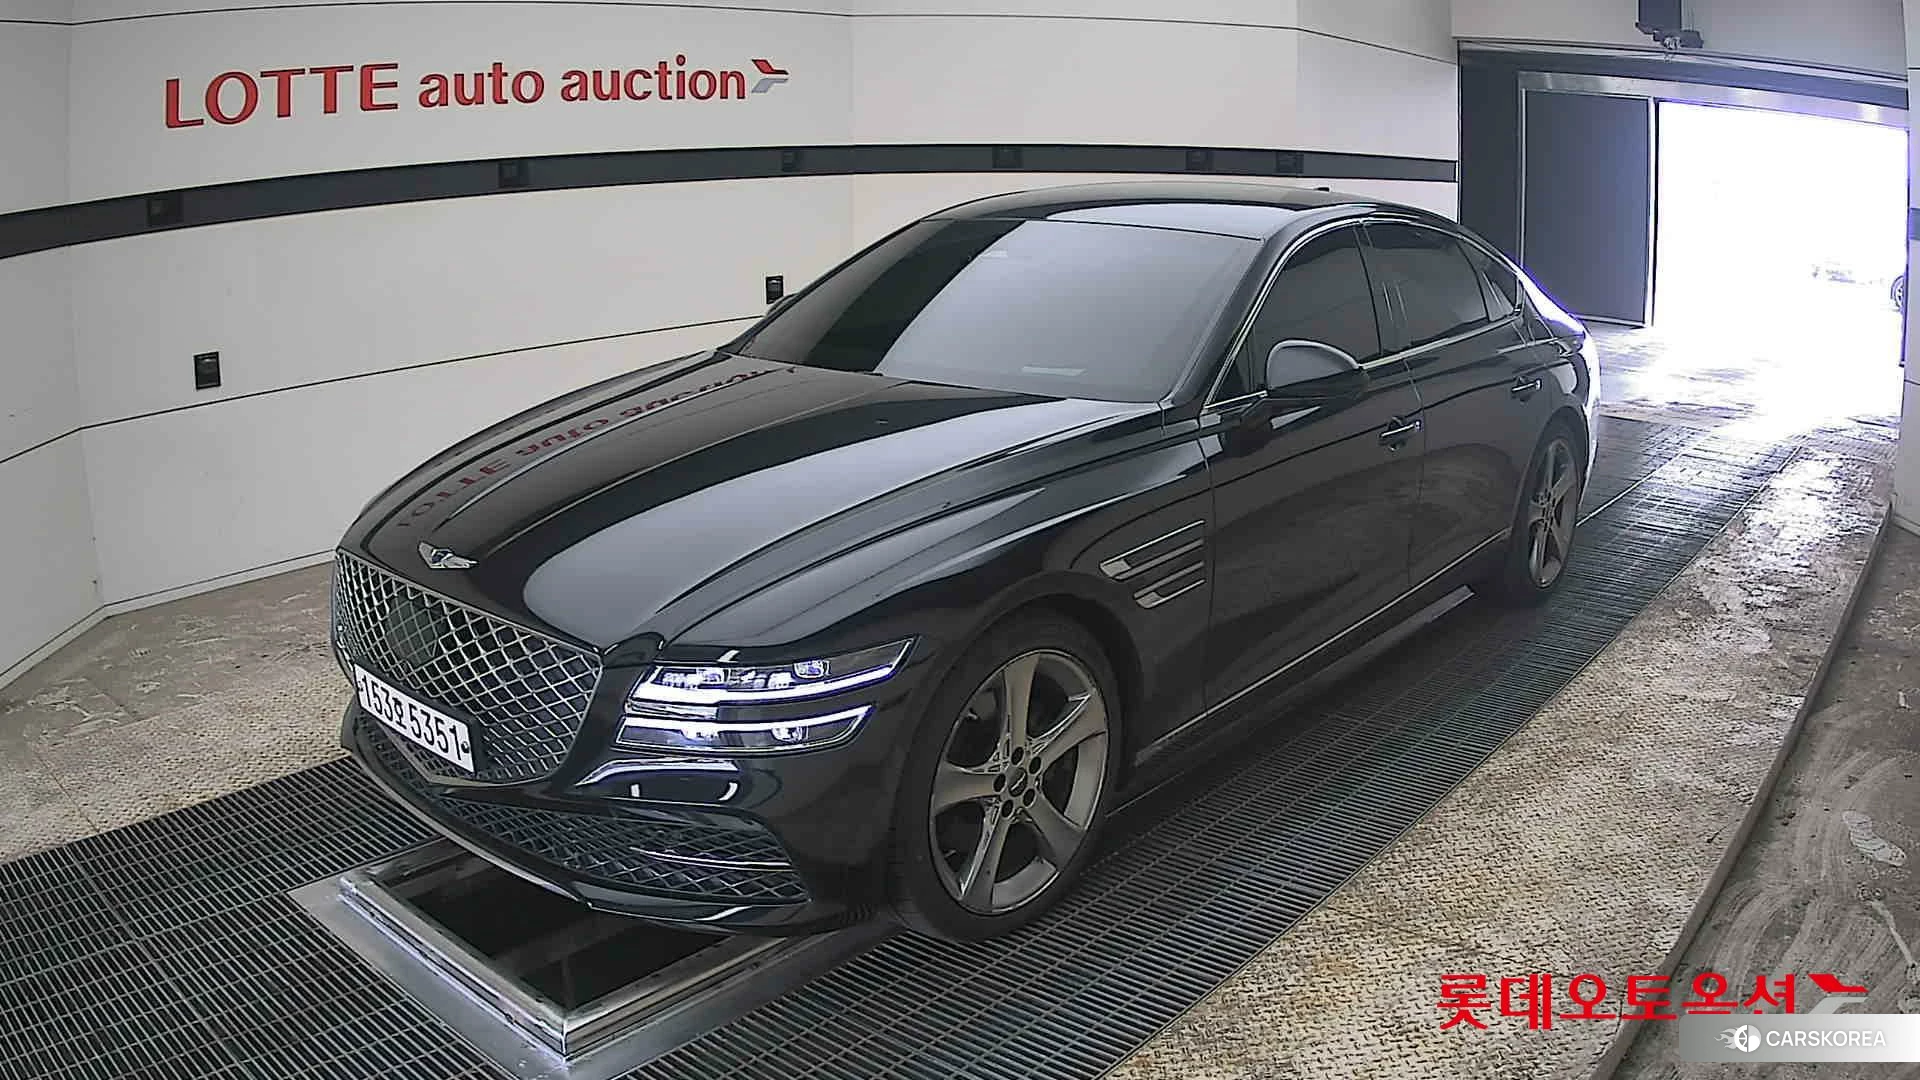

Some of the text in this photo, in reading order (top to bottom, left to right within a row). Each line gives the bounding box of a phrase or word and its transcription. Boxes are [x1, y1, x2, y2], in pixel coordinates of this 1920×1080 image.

[165, 54, 747, 128] LOTTE auto auction
[408, 703, 462, 761] 5351
